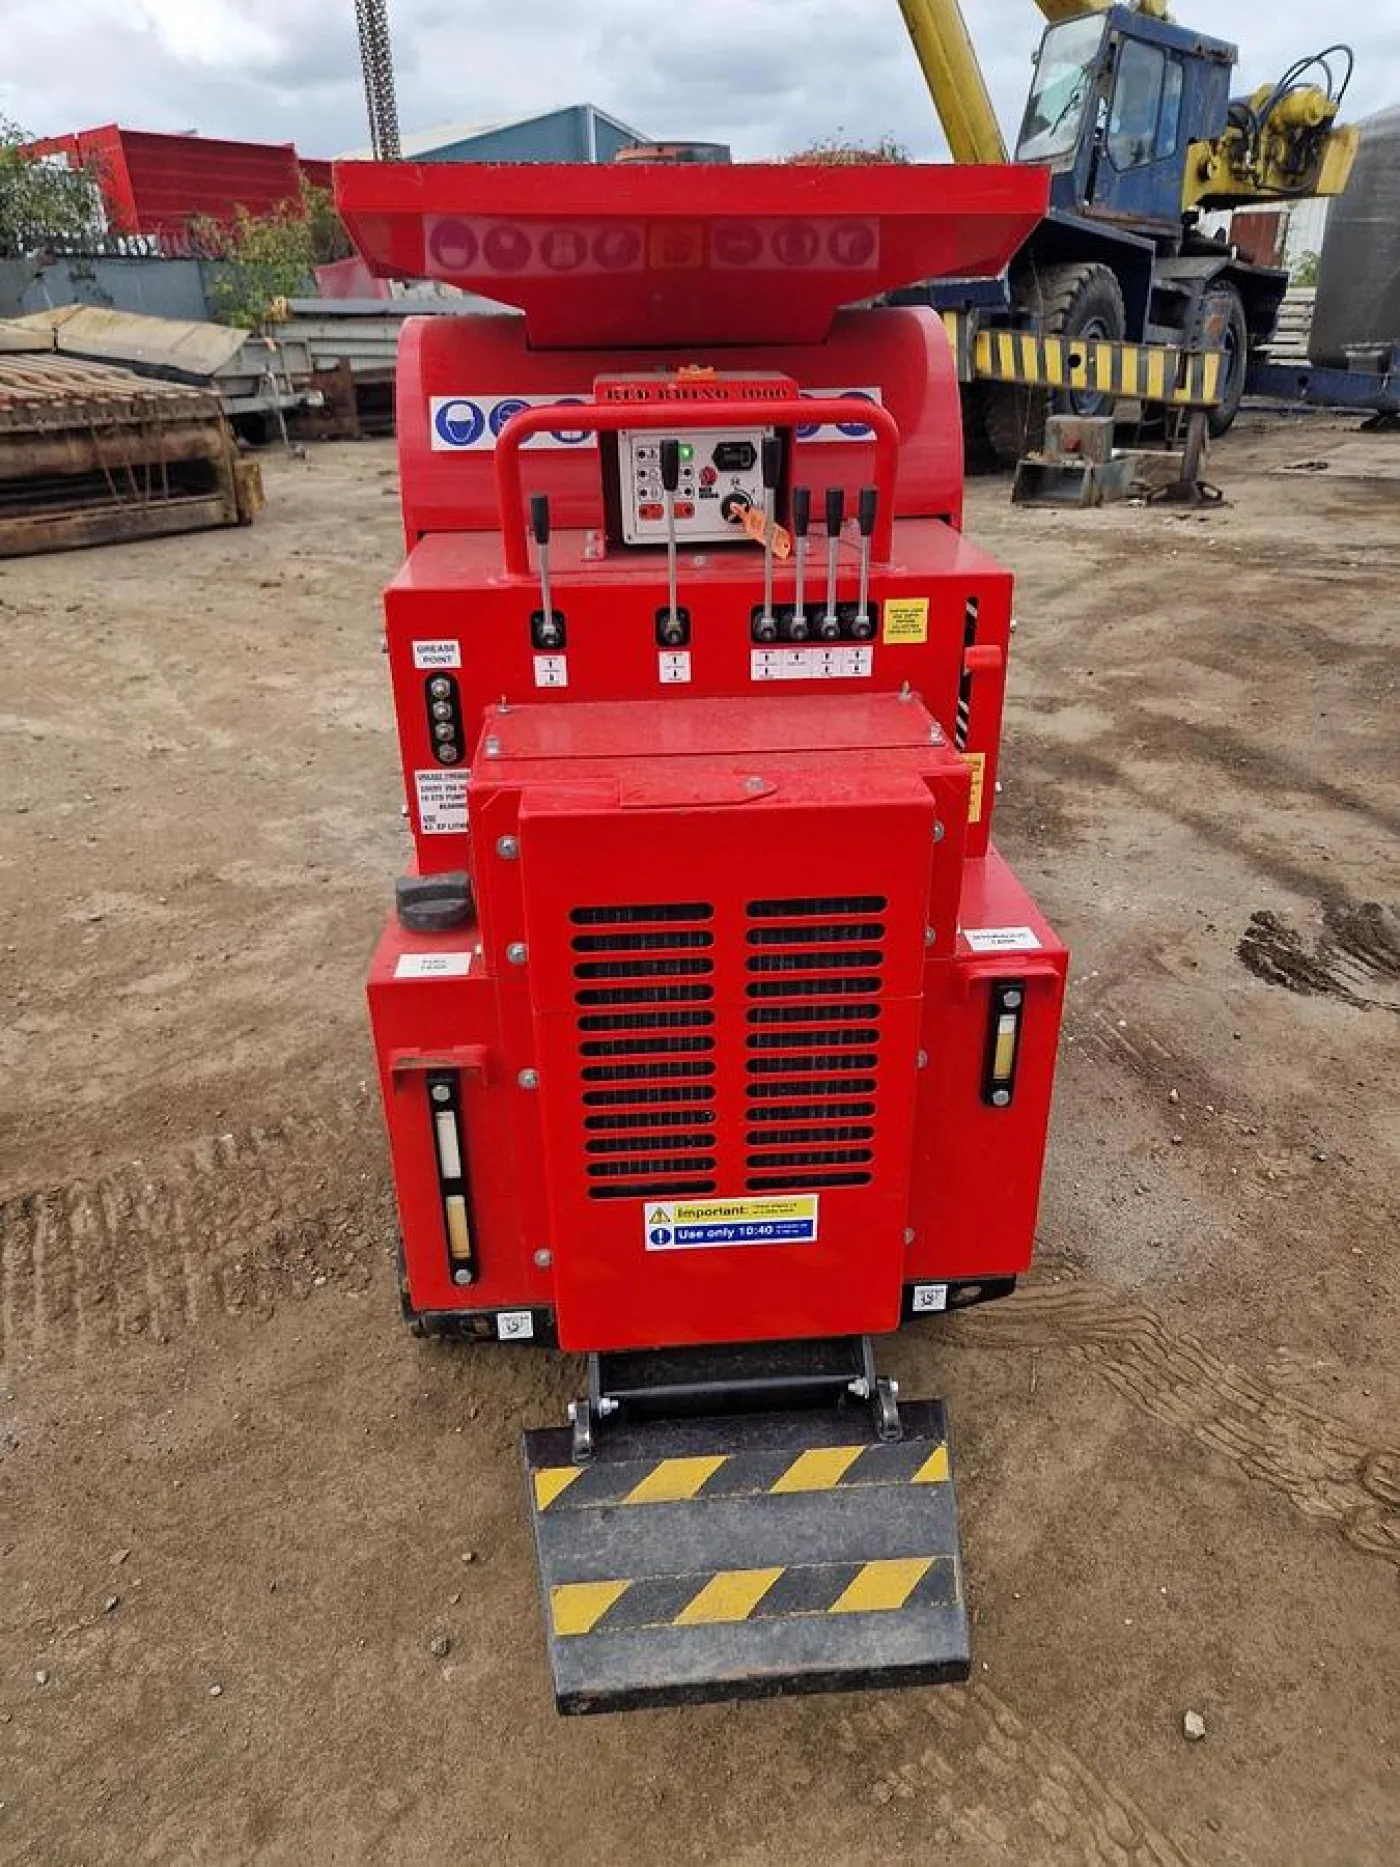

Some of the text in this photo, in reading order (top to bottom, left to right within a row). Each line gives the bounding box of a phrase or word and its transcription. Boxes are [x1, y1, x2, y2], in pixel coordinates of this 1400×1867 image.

[607, 389, 650, 400] RED
[422, 655, 453, 664] POINT
[677, 1206, 747, 1218] Important:
[678, 1229, 703, 1239] Use
[707, 1226, 735, 1238] only
[739, 1224, 774, 1235] 10:40
